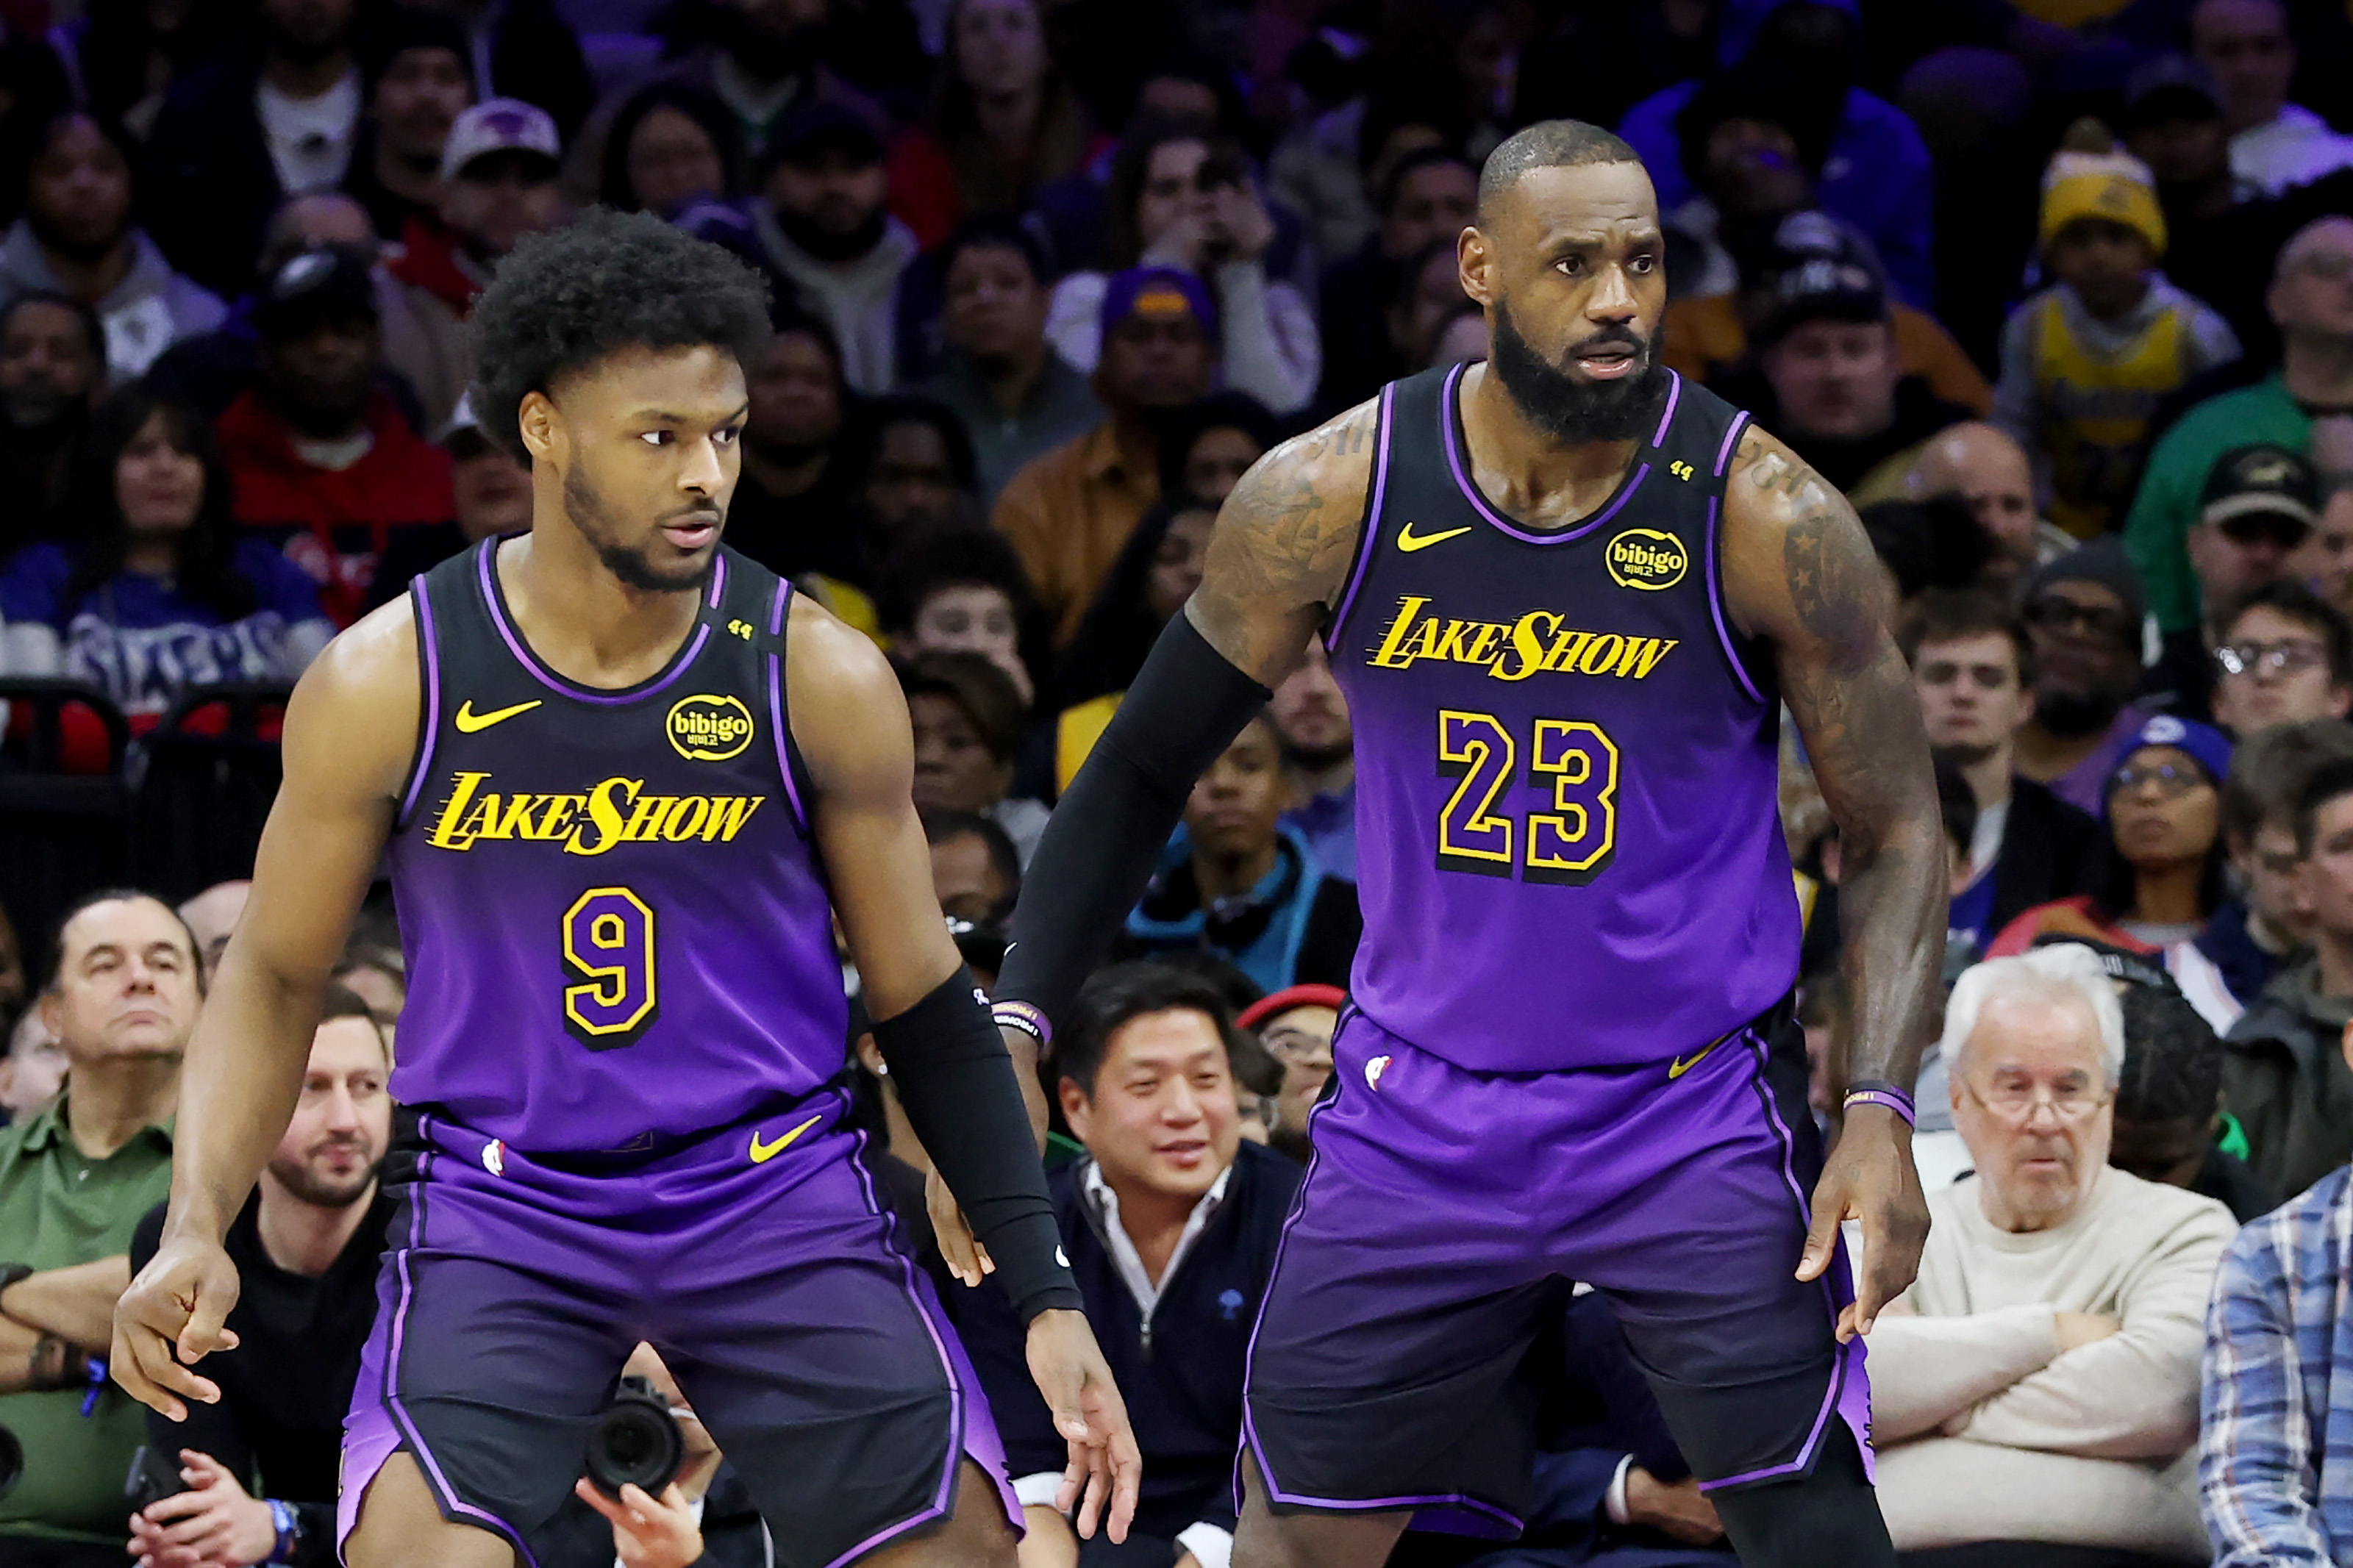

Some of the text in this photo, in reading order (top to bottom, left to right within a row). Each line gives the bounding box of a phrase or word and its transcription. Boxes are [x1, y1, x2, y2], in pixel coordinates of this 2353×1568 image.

[1670, 460, 1694, 482] 44
[1614, 543, 1682, 573] bibigo
[1624, 563, 1653, 576] 비비고
[727, 619, 753, 640] 44
[674, 710, 749, 742] bibigo
[687, 734, 719, 746] 비비고
[1437, 709, 1620, 884] 23
[563, 886, 658, 1048] 9
